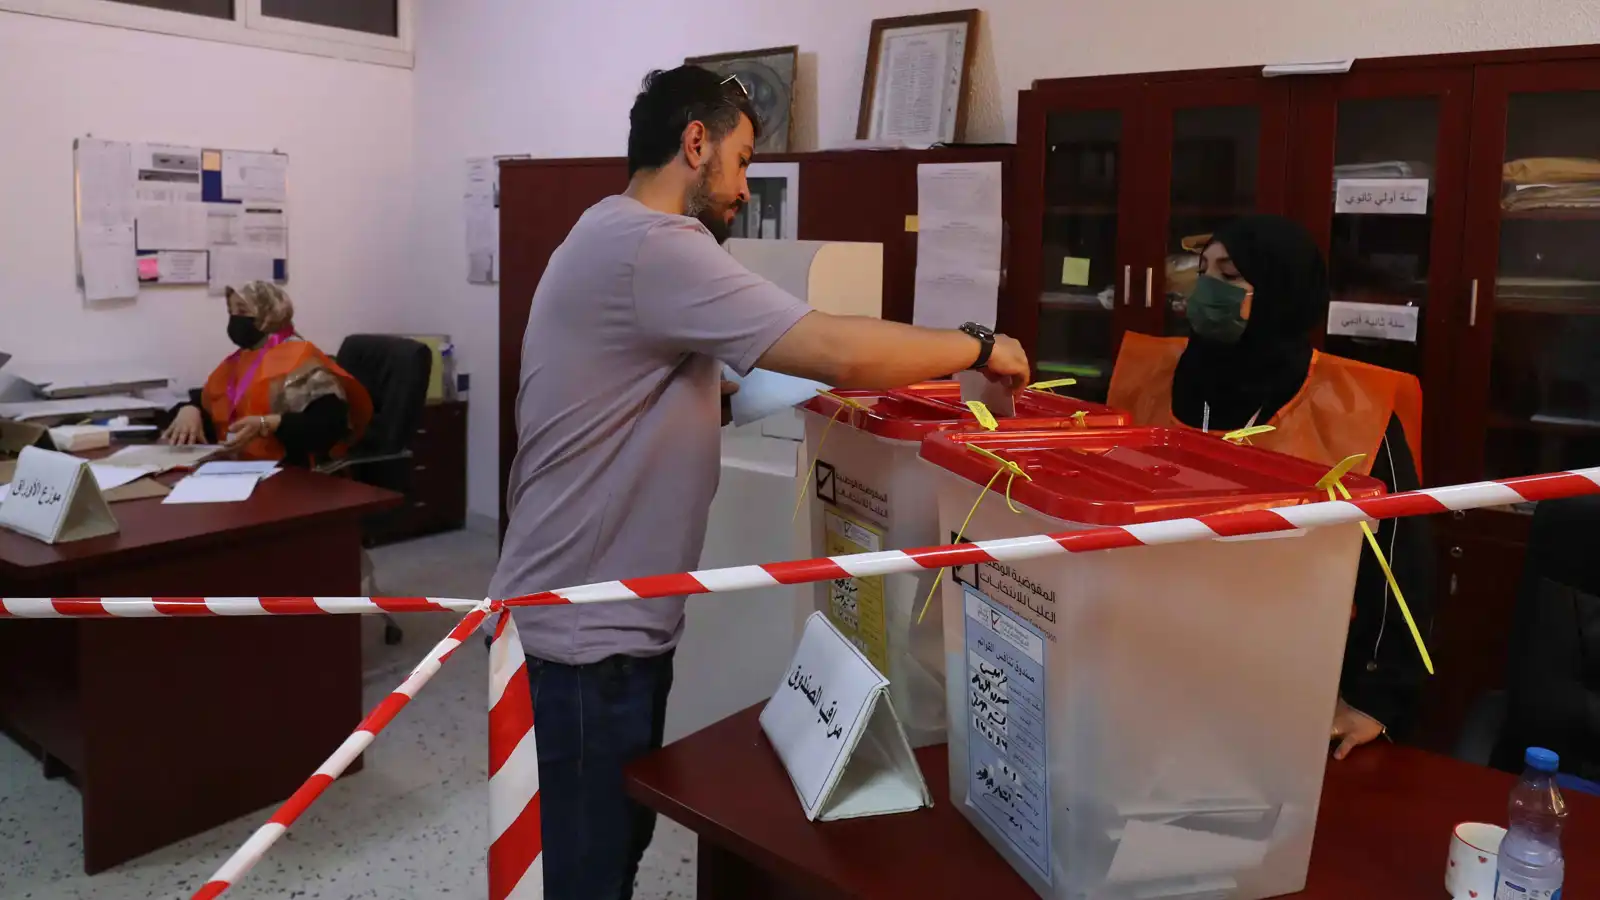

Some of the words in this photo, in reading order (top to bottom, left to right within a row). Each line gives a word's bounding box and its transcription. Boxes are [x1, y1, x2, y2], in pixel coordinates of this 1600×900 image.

[1344, 191, 1372, 206] ثانوي
[1400, 192, 1417, 202] سنة
[1387, 317, 1404, 328] سنة
[38, 485, 61, 505] موزع
[979, 571, 1027, 607] للانتخابات
[1011, 567, 1056, 604] المفوضية
[1026, 596, 1057, 625] العليا
[1012, 660, 1036, 684] صندوق
[787, 664, 823, 708] الصندوق
[816, 700, 843, 740] مراقب
